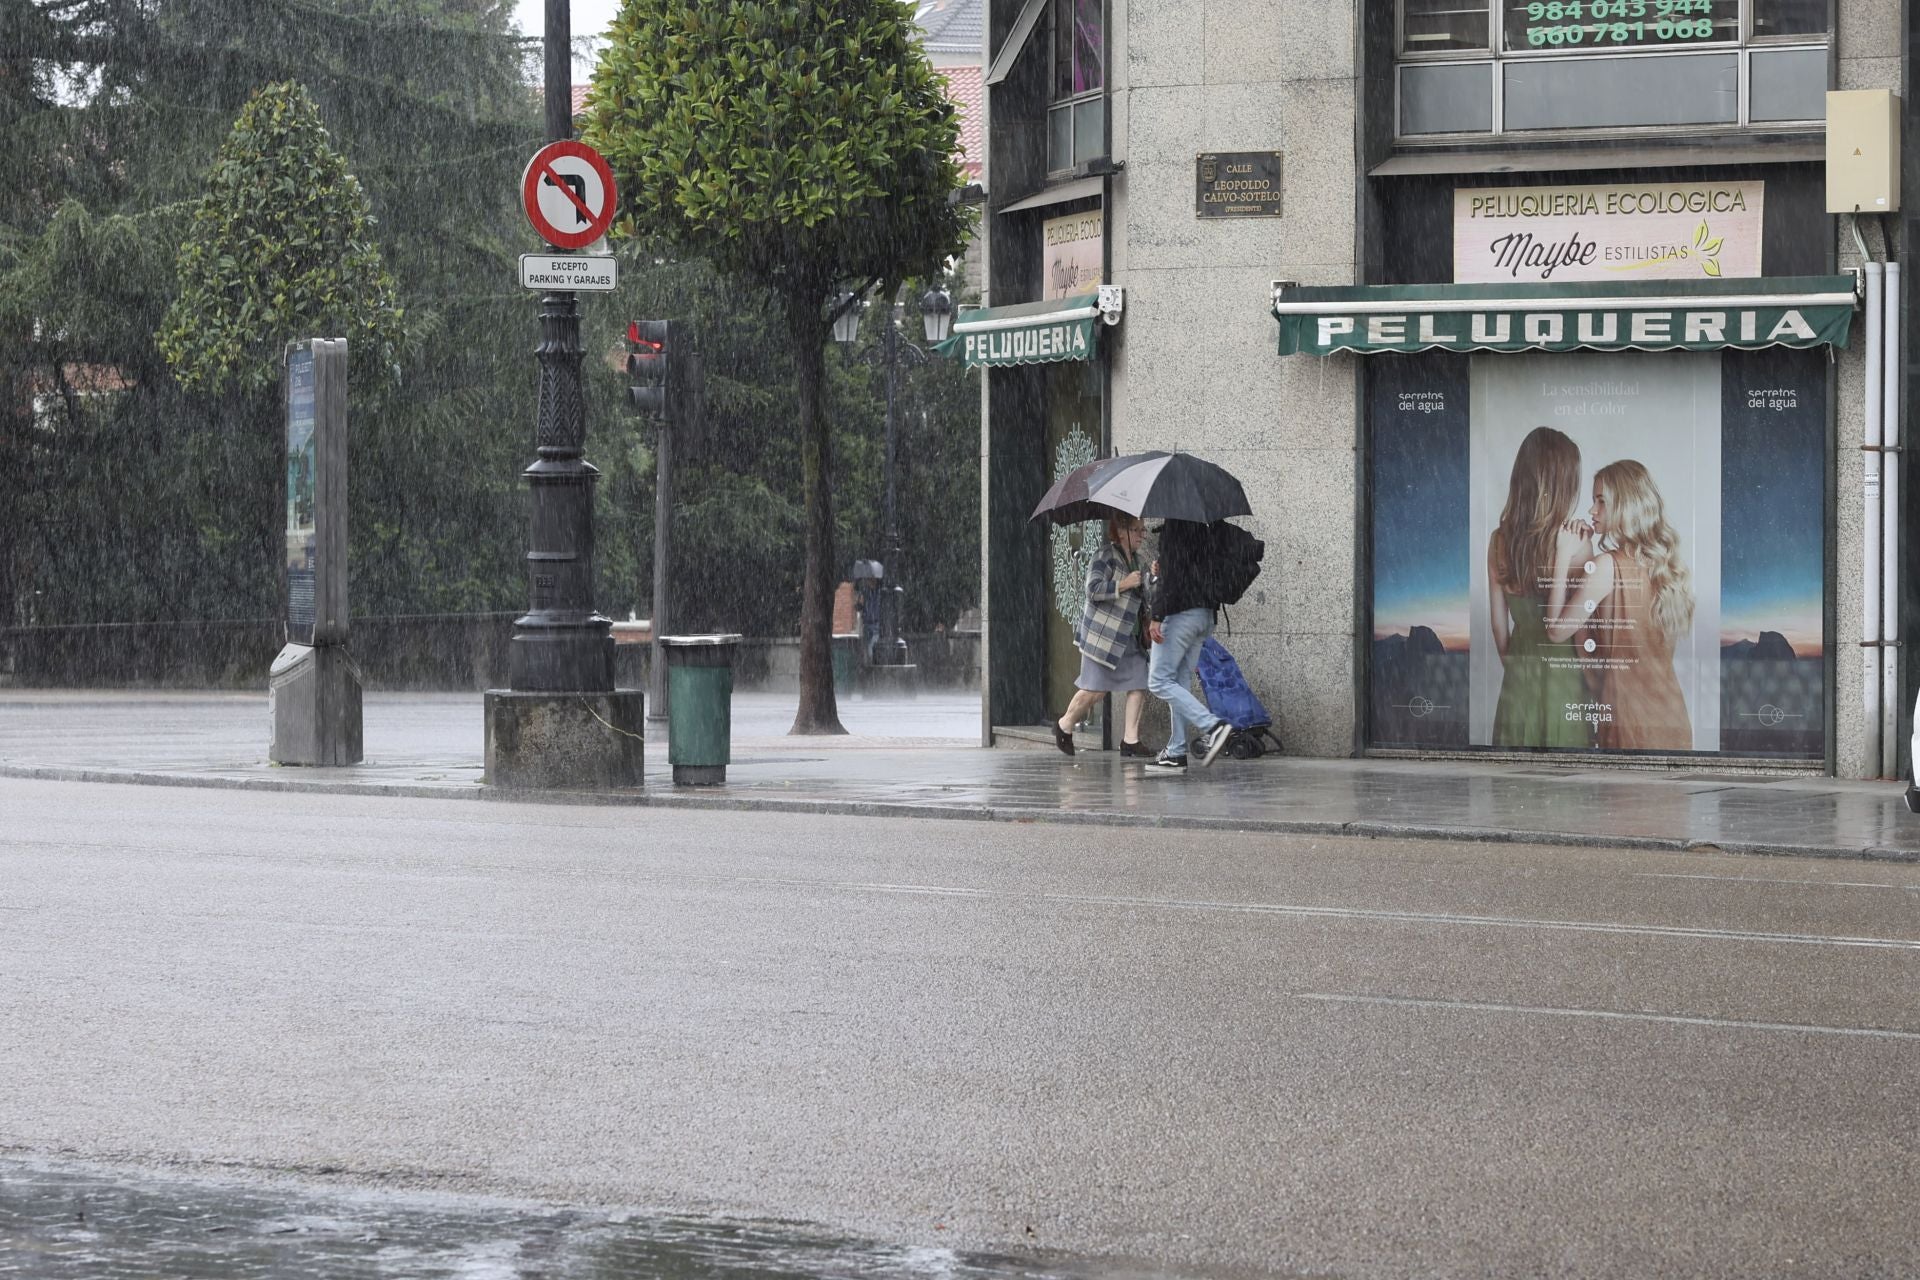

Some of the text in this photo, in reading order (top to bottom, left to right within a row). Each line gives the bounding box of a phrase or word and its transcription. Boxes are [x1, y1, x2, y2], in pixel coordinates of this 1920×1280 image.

[1527, 0, 1713, 21] 984 043 944
[1528, 18, 1713, 46] 660 781 068
[1226, 164, 1252, 173] CALLE
[1214, 180, 1269, 190] LEOPOLDO
[1203, 191, 1280, 202] CALVO-SOTELO
[1471, 188, 1746, 218] PELUQUERIA ECOLOGICA
[1047, 222, 1080, 247] PELUQUERIA
[1490, 232, 1688, 279] Maybe ESTILISTAS
[551, 262, 588, 271] EXCEPTO
[529, 274, 610, 285] PARKING Y GARAJES
[1052, 256, 1078, 300] Maybe
[1317, 309, 1817, 346] PELUQUERIA
[964, 324, 1086, 361] PELUQUERIA
[1398, 391, 1444, 400] secretos
[1542, 381, 1639, 397] La sensibilidad
[1748, 388, 1797, 397] secretos
[1398, 401, 1444, 413] del agua
[1554, 402, 1627, 416] en el Color
[1748, 398, 1797, 411] del agua
[1565, 702, 1612, 711] secretos
[1565, 711, 1612, 724] del agua
